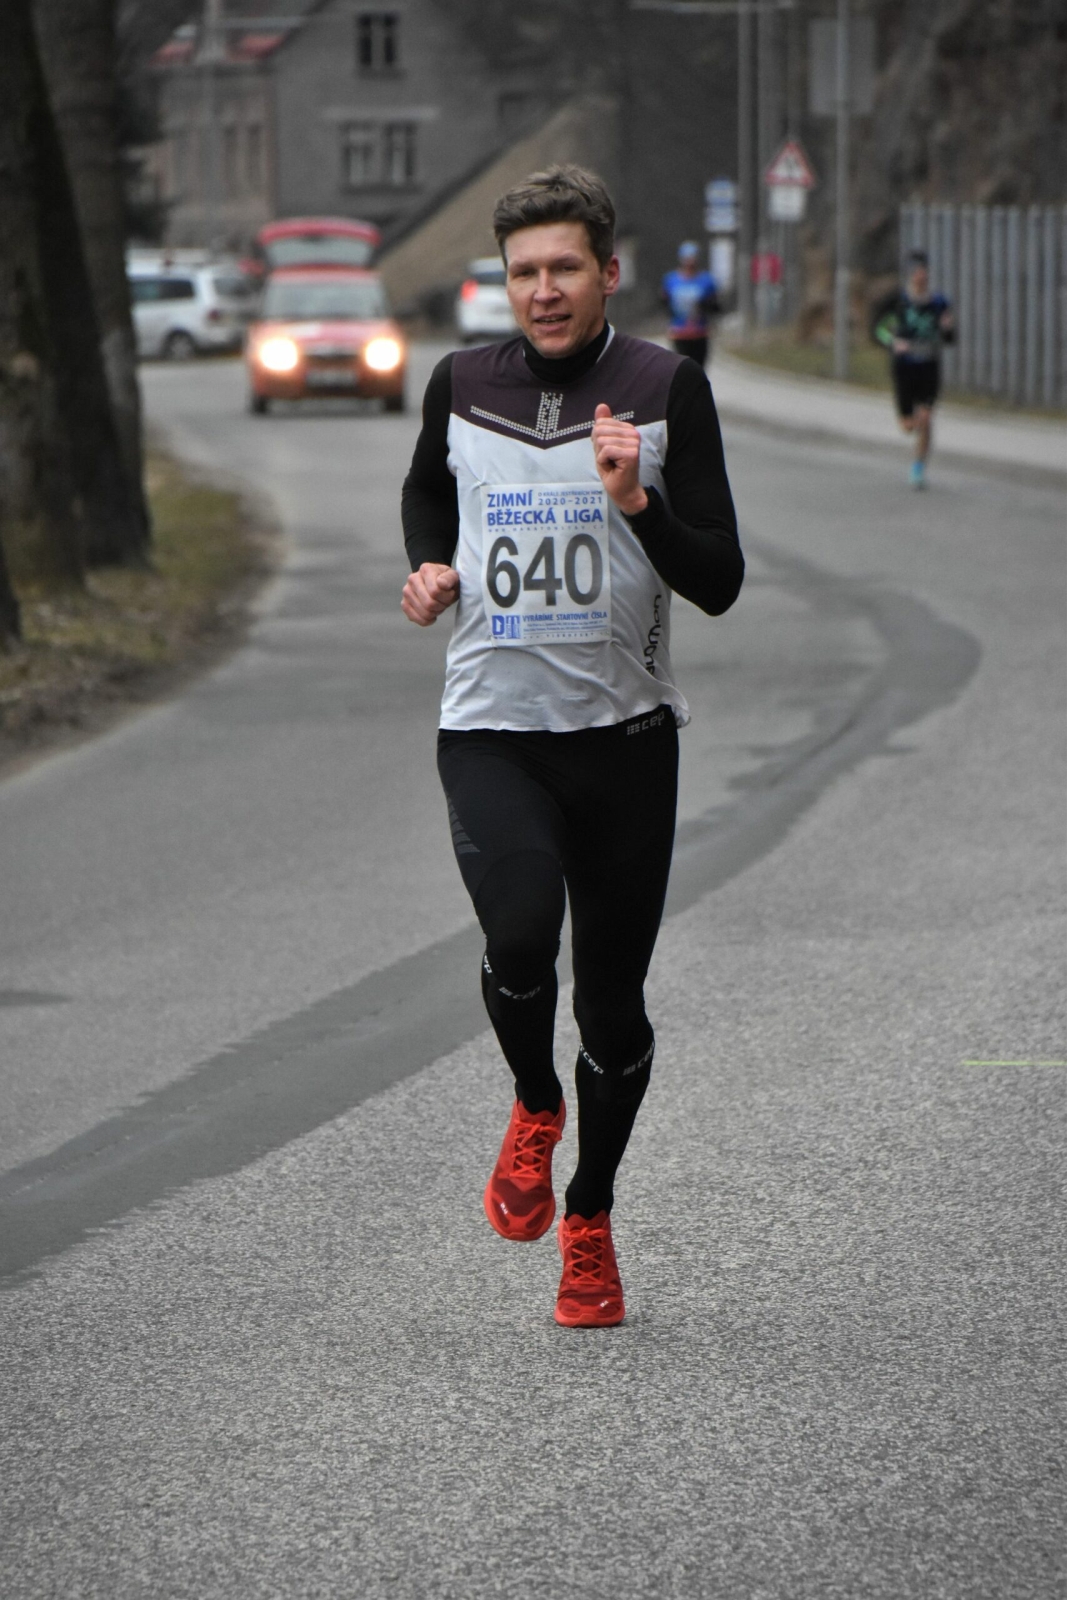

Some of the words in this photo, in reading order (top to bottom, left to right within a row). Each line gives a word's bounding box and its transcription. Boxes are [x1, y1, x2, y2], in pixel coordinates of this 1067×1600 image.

[487, 489, 533, 508] ZIMNÍ
[487, 507, 556, 526] BĚŽECKÁ
[564, 508, 603, 524] LIGA
[486, 533, 603, 608] 640
[641, 710, 665, 731] cep
